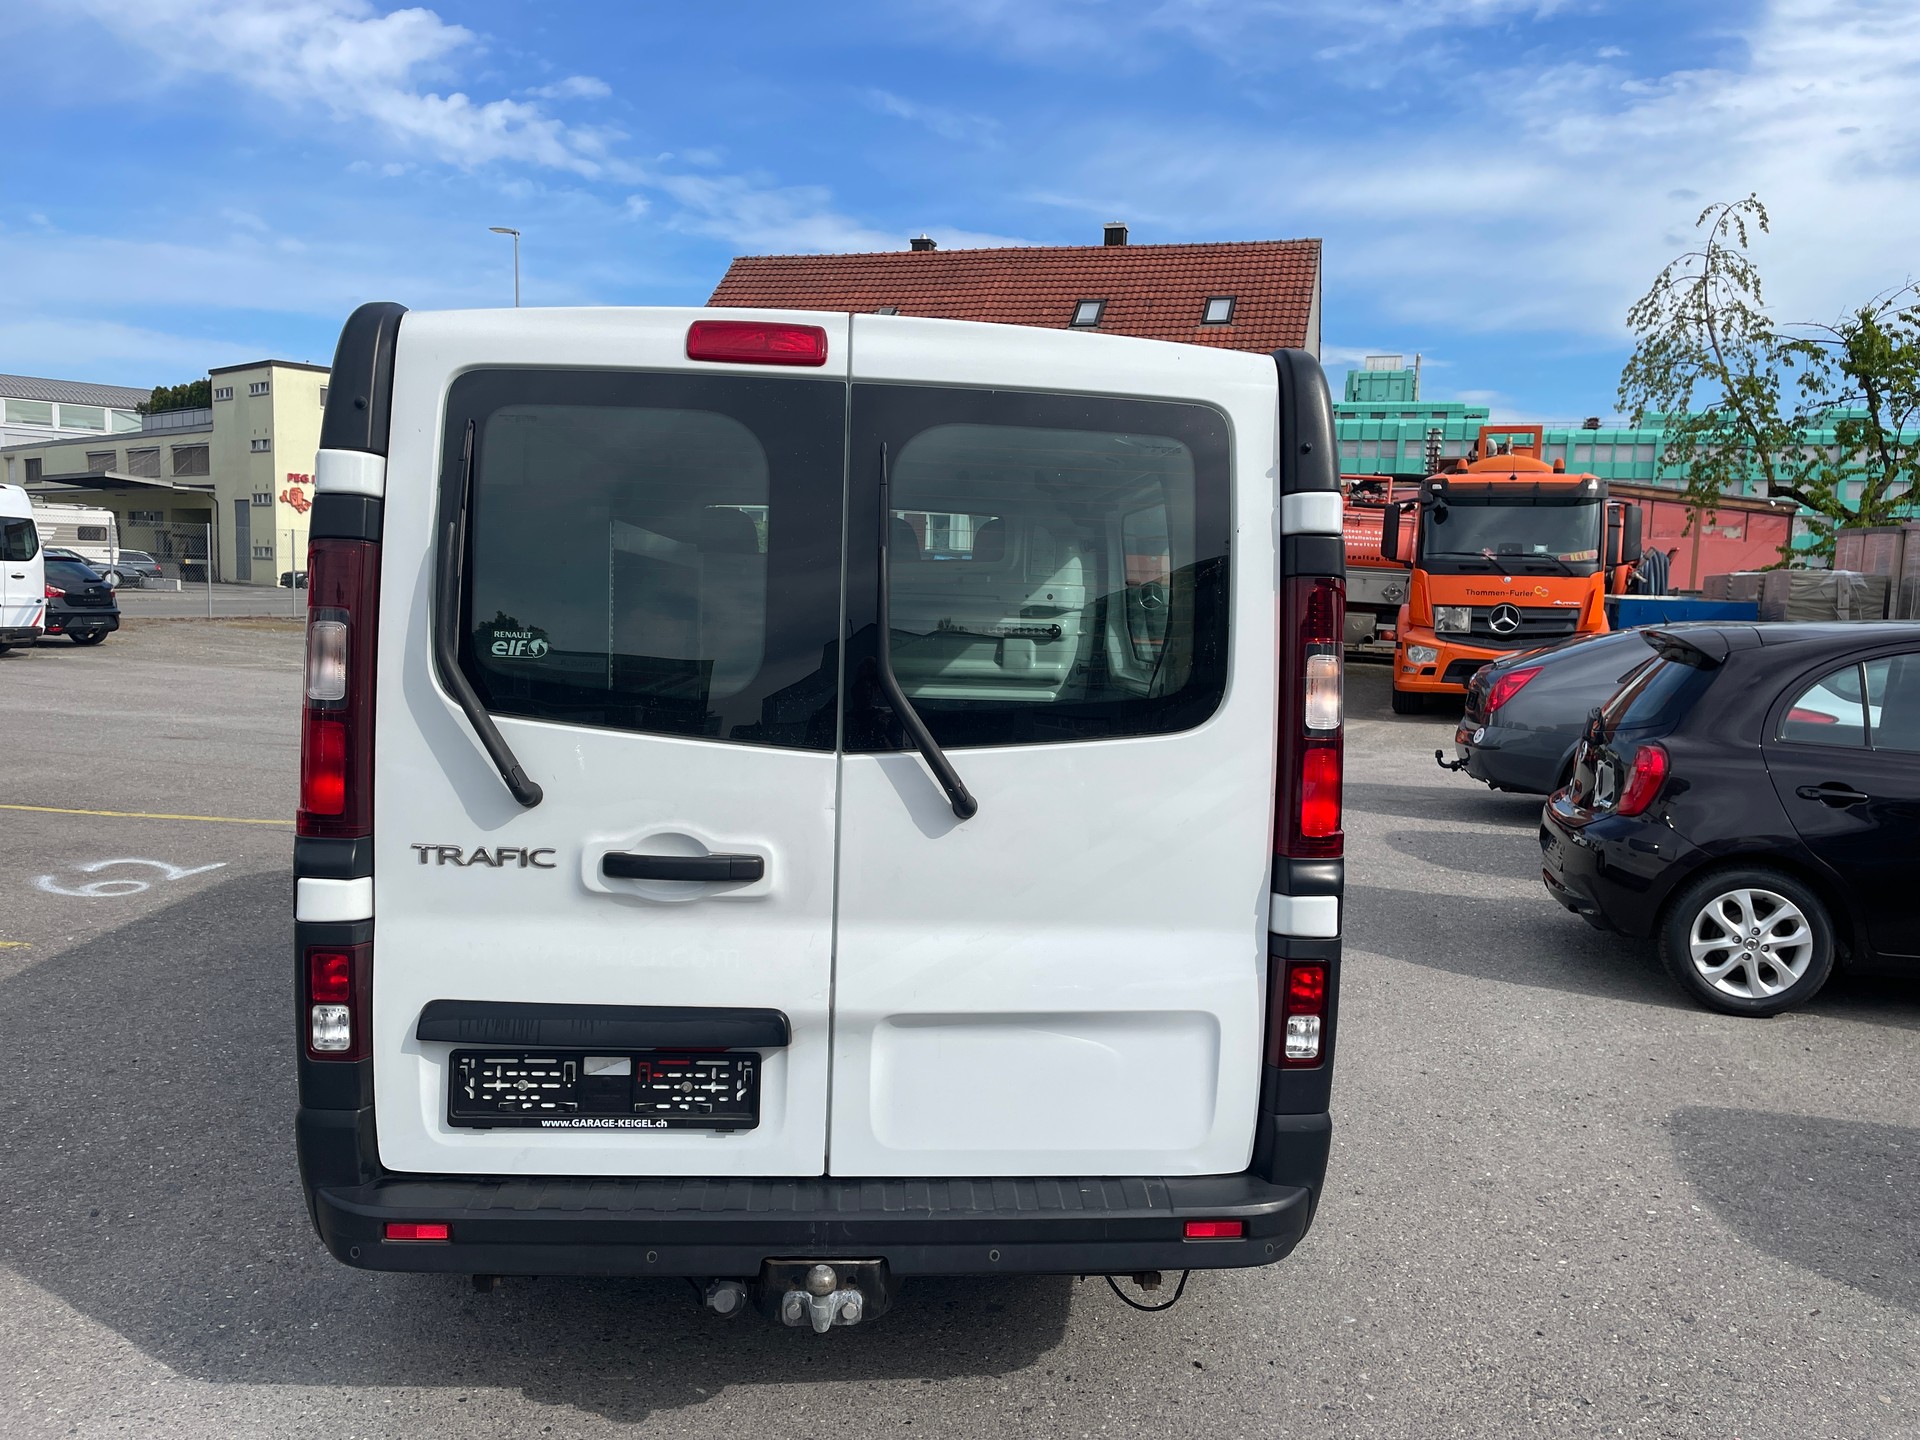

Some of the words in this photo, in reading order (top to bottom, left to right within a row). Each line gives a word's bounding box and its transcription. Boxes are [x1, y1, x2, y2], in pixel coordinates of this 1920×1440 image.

[493, 630, 533, 639] RENAULT
[491, 640, 528, 656] elf
[410, 843, 557, 869] TRAFIC
[541, 1119, 668, 1128] www.GARAGE-KEIGEL.ch
